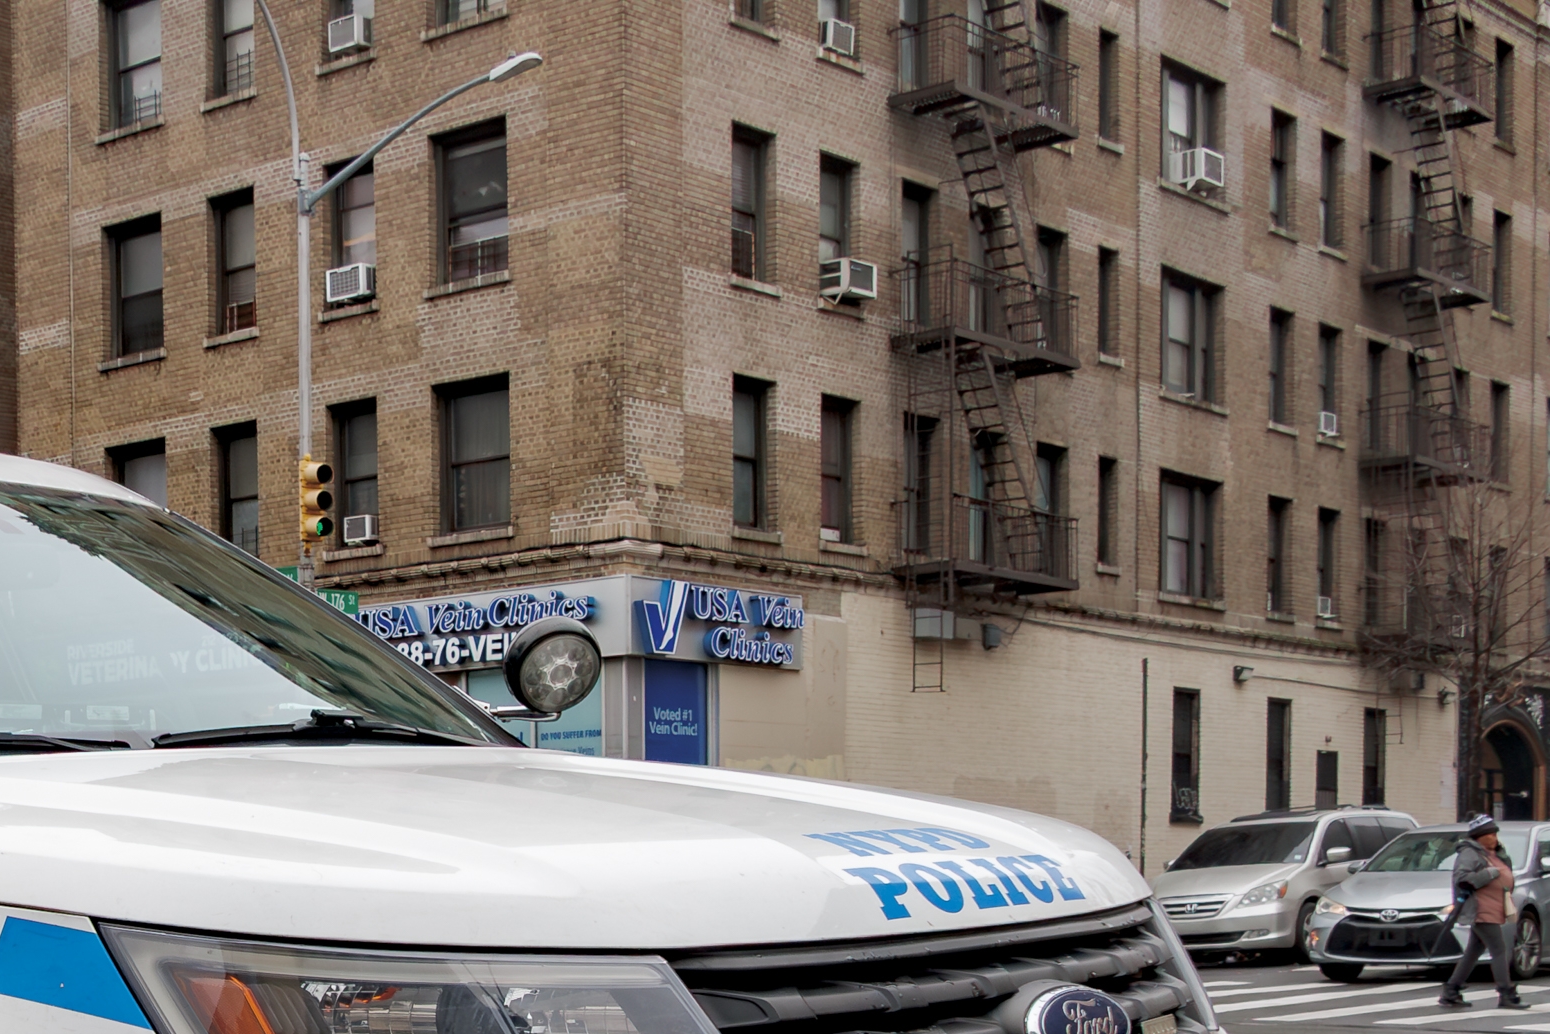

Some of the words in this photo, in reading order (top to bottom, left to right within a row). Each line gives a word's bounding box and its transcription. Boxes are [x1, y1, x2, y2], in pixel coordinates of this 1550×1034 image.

[331, 595, 345, 611] 176
[354, 605, 418, 639] USA
[425, 599, 485, 635] Vein
[487, 590, 589, 629] Clinics
[691, 585, 749, 623] USA
[757, 595, 805, 630] Vein
[711, 626, 794, 664] Clinics
[649, 721, 670, 735] Vein
[671, 722, 698, 736] Clinic!
[653, 706, 681, 722] Voted
[682, 709, 693, 722] #1
[550, 731, 562, 740] YOU
[563, 730, 584, 739] SUFFER
[585, 729, 601, 738] FROM
[802, 827, 990, 857] NYPD
[842, 854, 1086, 921] POLICE
